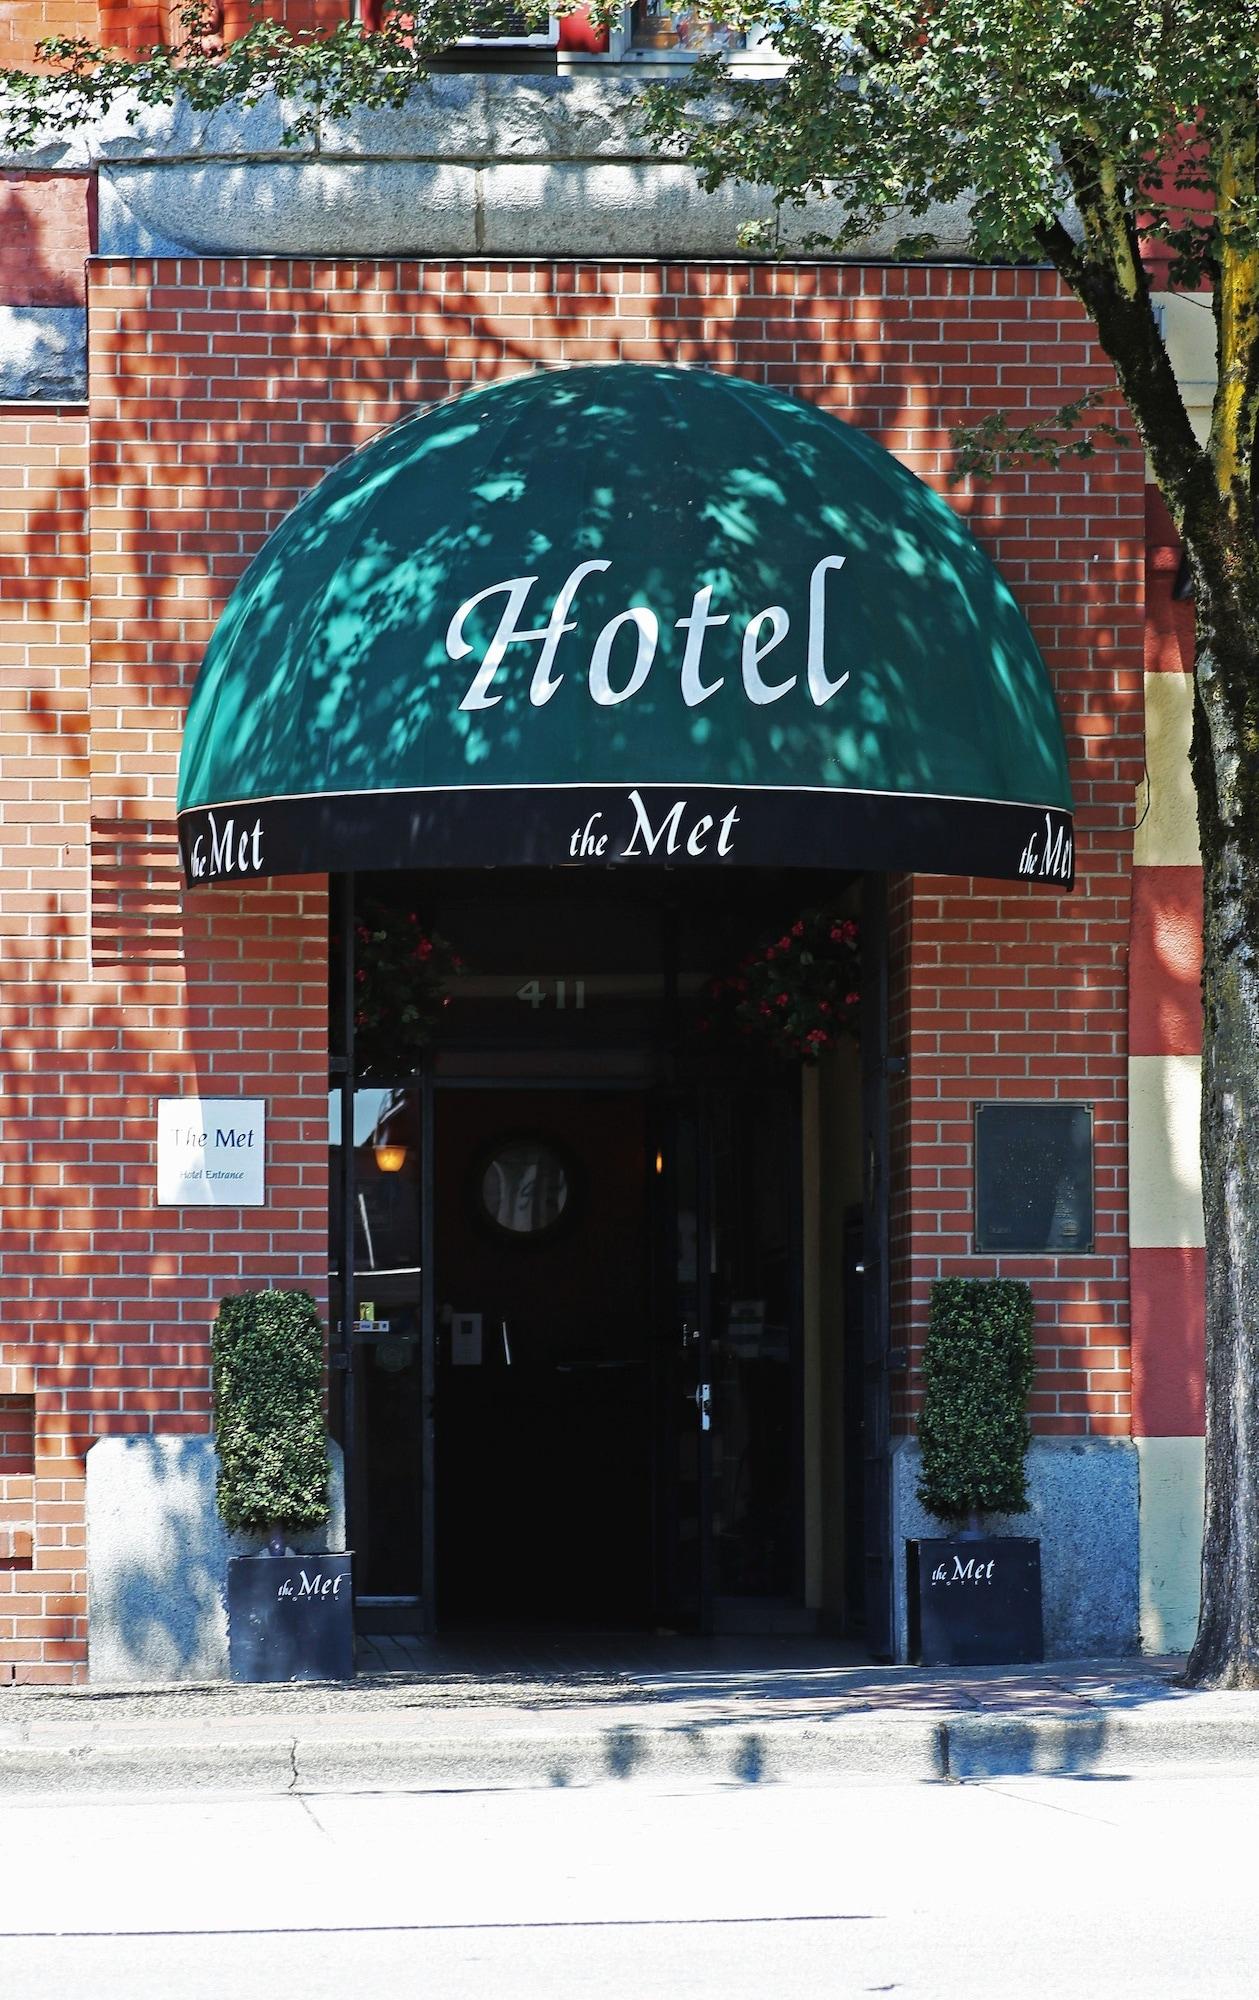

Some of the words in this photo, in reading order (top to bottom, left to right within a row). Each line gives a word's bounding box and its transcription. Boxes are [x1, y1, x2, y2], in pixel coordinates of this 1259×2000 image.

[445, 554, 850, 711] Hotel
[568, 811, 609, 857] the
[619, 789, 741, 857] Met
[207, 811, 265, 876] Met
[1019, 831, 1039, 874] the
[516, 980, 586, 1009] 411
[171, 1127, 208, 1148] The
[214, 1128, 255, 1148] Met
[205, 1170, 245, 1180] Entrance
[277, 1578, 294, 1596] the
[297, 1569, 342, 1596] Met
[931, 1563, 948, 1581] the
[951, 1555, 996, 1581] Met
